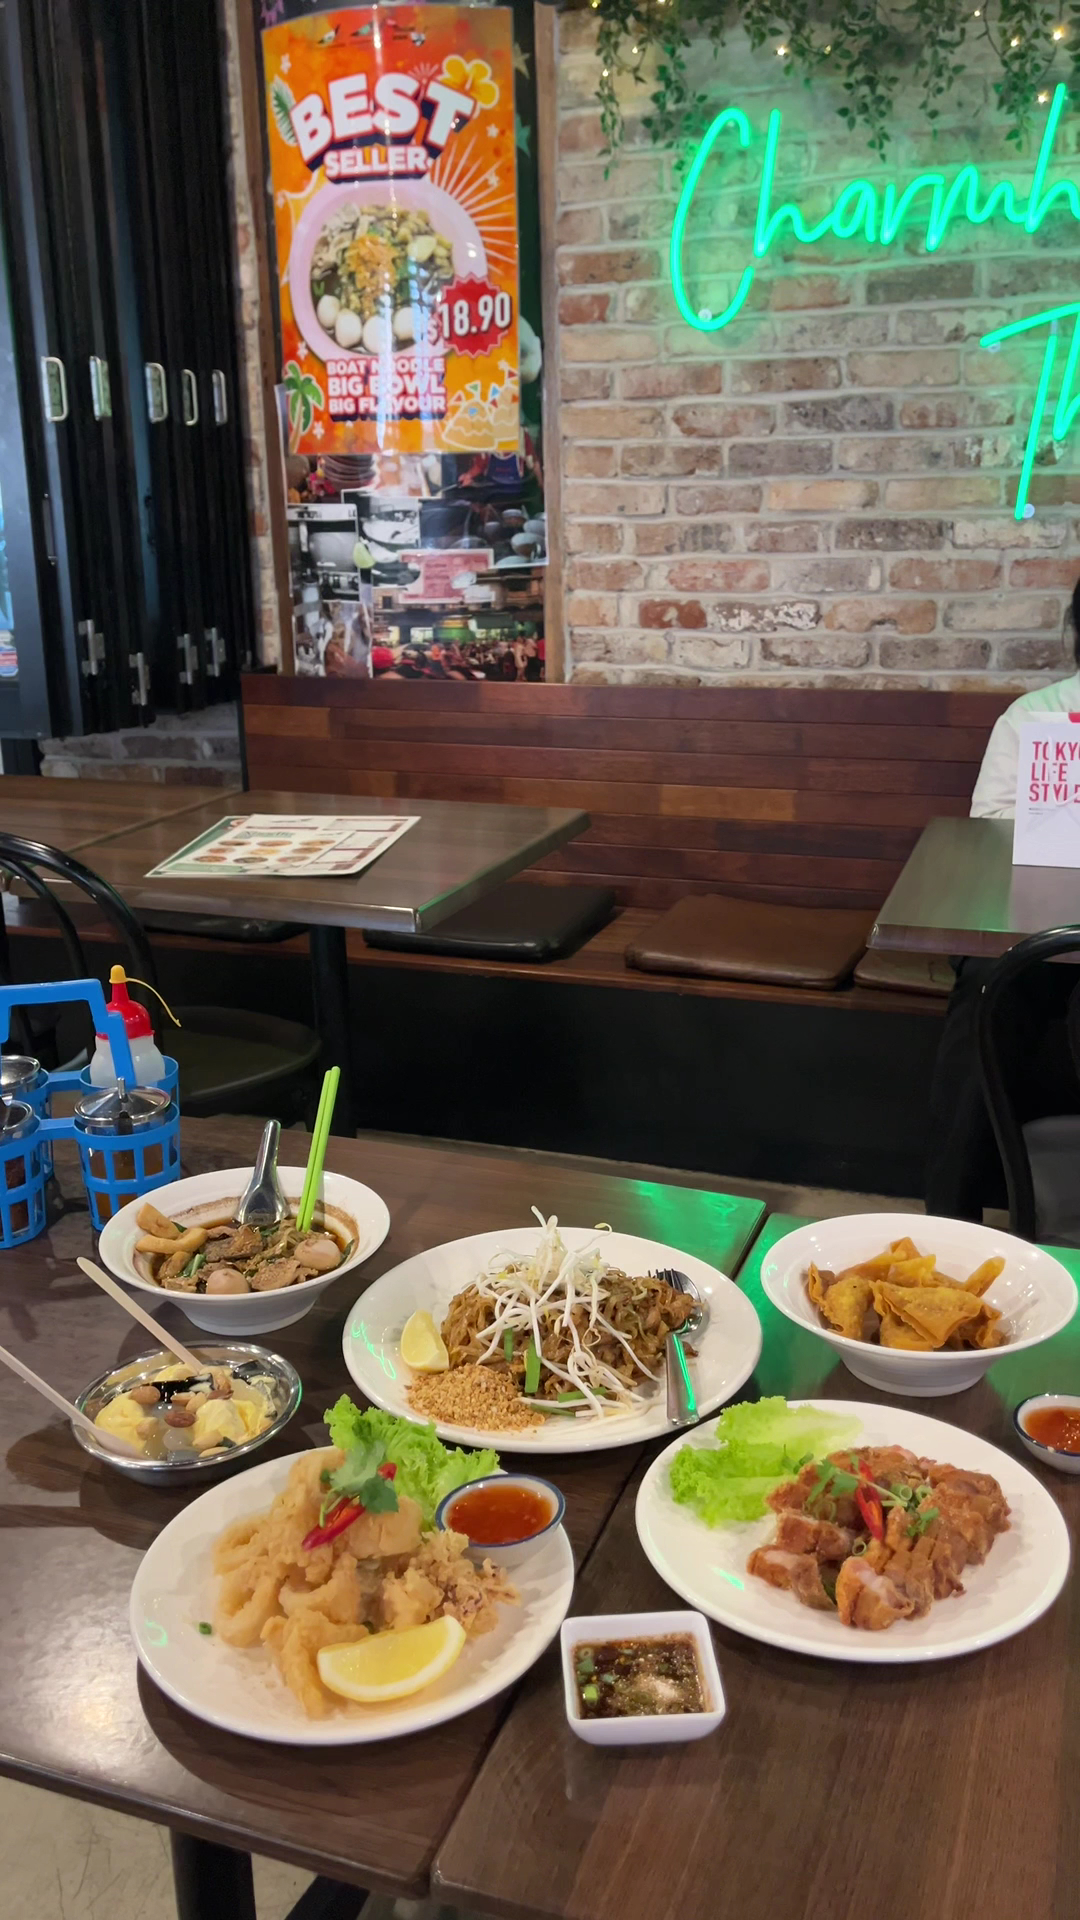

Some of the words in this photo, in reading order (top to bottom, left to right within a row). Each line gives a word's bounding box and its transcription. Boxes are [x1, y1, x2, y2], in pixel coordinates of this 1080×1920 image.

[290, 72, 475, 163] BEST
[324, 146, 428, 176] SELLER
[427, 291, 511, 345] $18.90
[327, 360, 367, 375] BOAT
[371, 358, 445, 374] NODLE
[328, 375, 364, 397] BIG
[369, 373, 446, 397] BOWL
[329, 397, 356, 413] BIG
[359, 395, 446, 413] FLVOUR
[1031, 741, 1080, 761] TOKY
